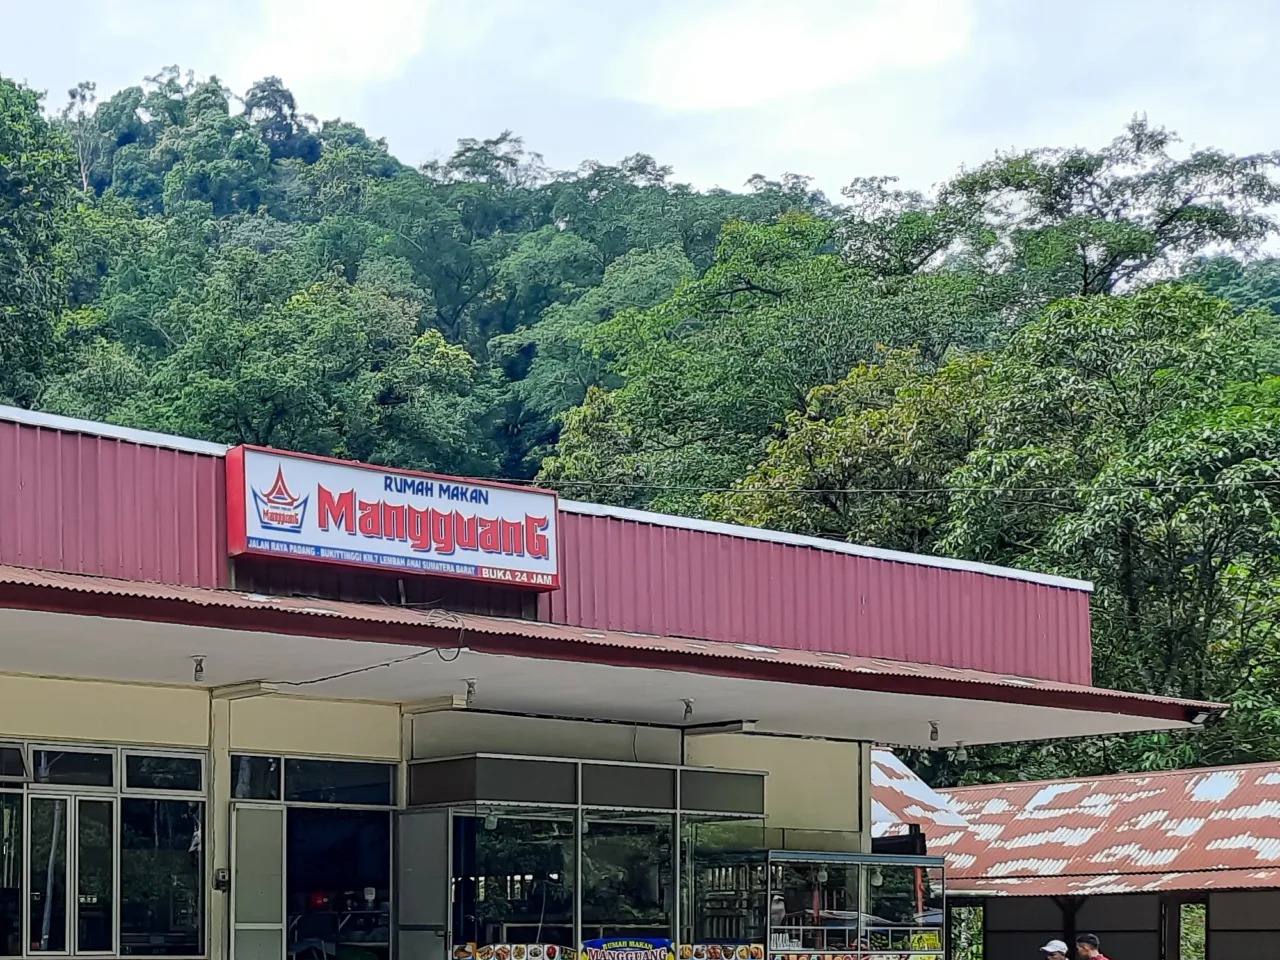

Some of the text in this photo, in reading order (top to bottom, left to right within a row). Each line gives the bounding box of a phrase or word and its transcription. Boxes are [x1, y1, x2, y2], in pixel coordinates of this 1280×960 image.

[384, 475, 489, 505] RUMAH MAKAN
[248, 538, 270, 550] JALAN
[271, 541, 288, 552] RAYA
[289, 544, 316, 556] PADANG
[321, 548, 362, 561] BUKITTINGGI
[380, 556, 405, 566] LEMBAH
[406, 558, 421, 568] ANAI
[423, 561, 455, 573] SUMATERA
[455, 565, 475, 575] BARAT
[482, 568, 553, 585] BUKA 24 JAM
[602, 940, 654, 950] RUMAH MAKAN
